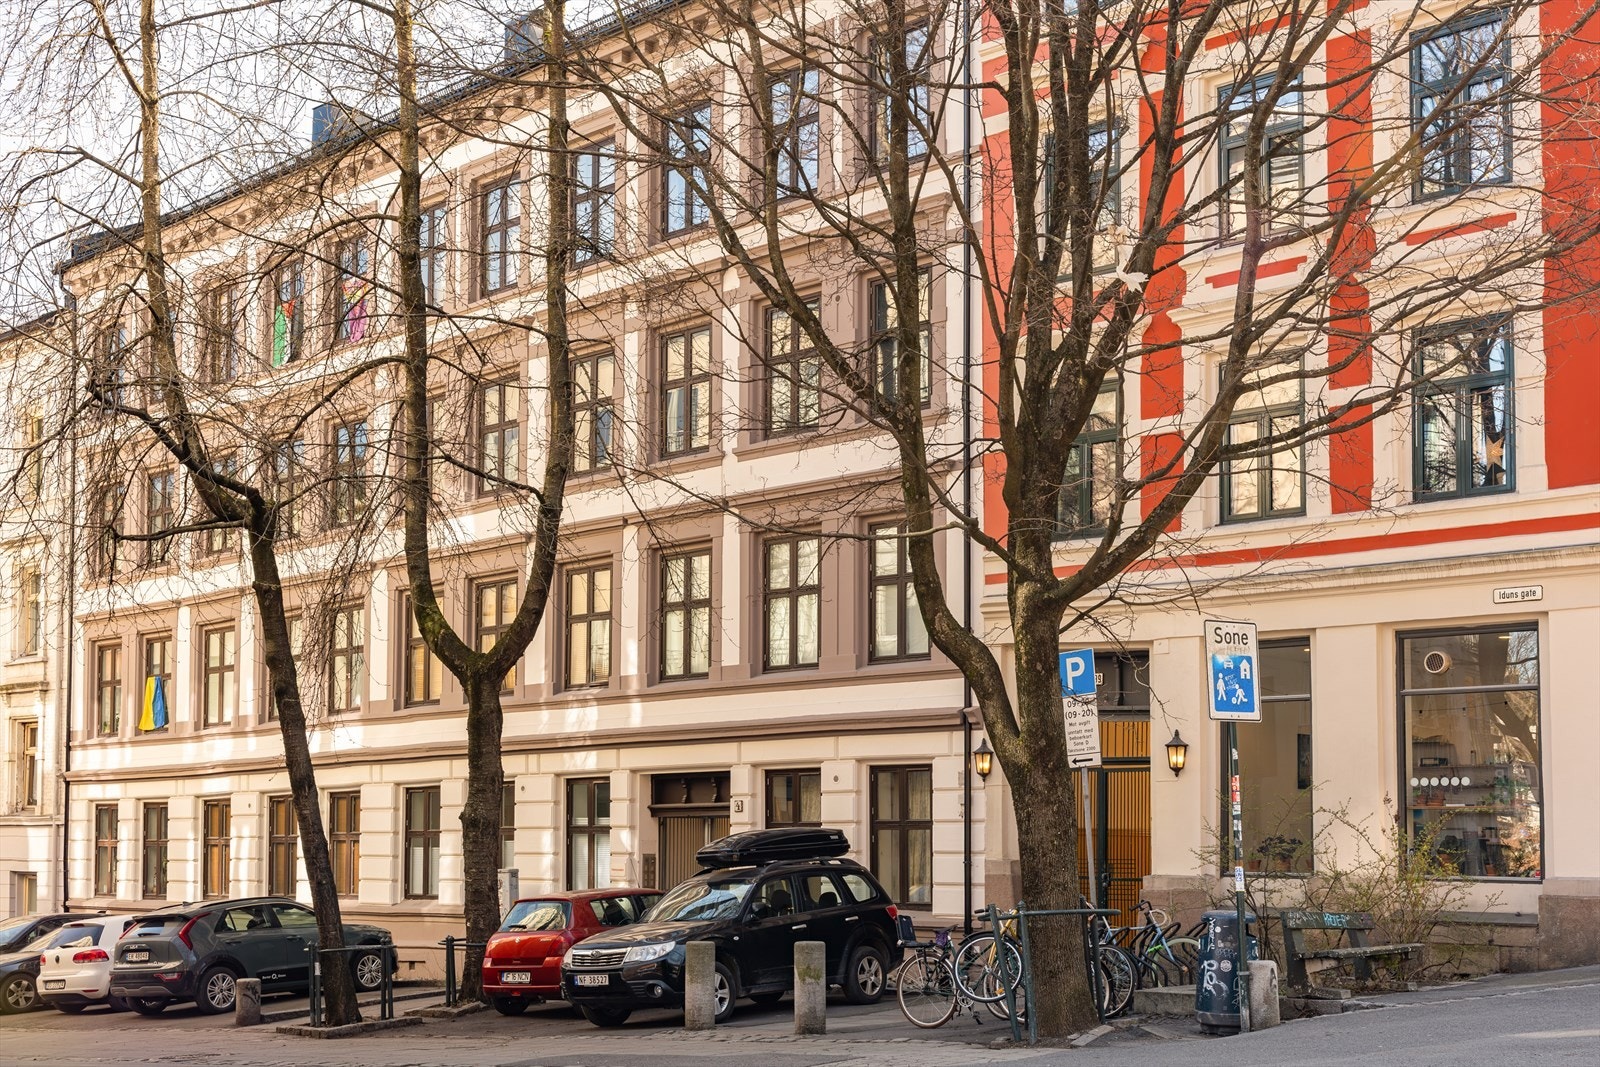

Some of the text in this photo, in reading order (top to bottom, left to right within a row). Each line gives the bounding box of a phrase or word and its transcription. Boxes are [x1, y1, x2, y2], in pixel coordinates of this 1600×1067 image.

[1498, 589, 1537, 600] Iduns gate
[1214, 626, 1249, 646] Sone
[1066, 656, 1085, 690] P
[589, 975, 607, 985] 38527
